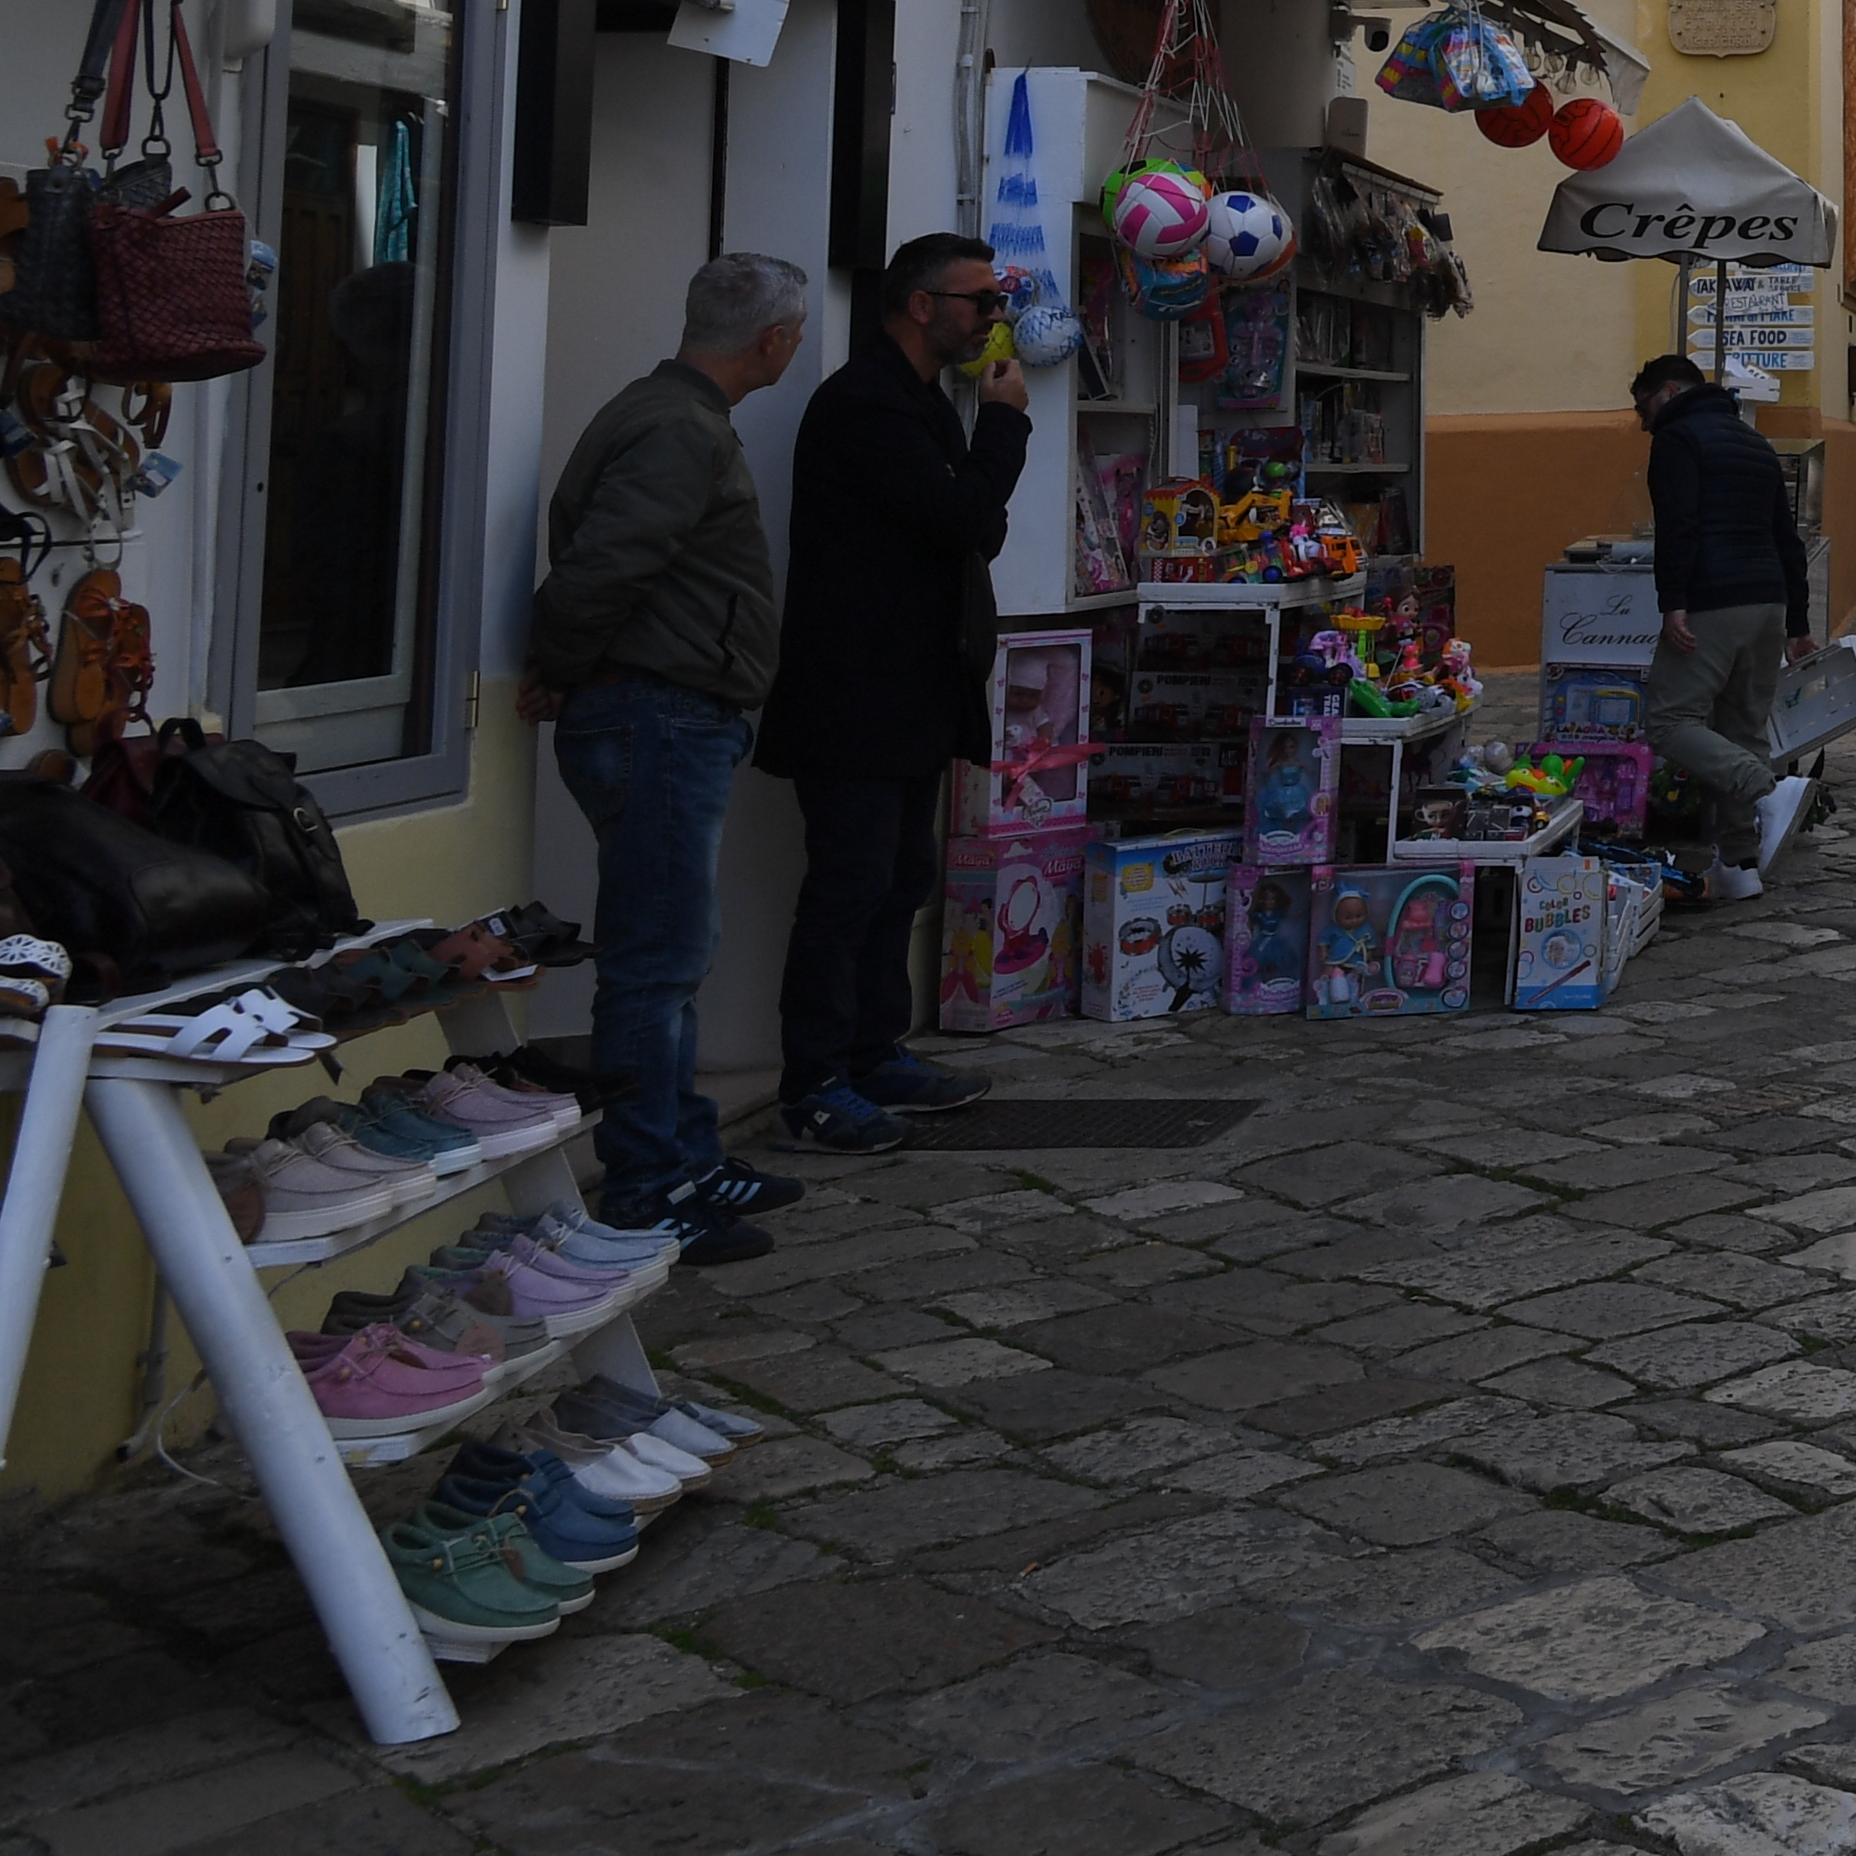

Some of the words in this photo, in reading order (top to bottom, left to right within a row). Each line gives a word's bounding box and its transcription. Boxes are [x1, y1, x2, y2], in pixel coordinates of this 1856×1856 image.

[1580, 202, 1799, 249] Crêpes
[1722, 330, 1745, 345] SEA
[1750, 330, 1788, 345] FOOD
[1109, 745, 1164, 757] POMPIERI
[954, 853, 991, 867] Maya
[1044, 856, 1083, 876] Maya
[1539, 896, 1569, 911] COLOR
[1524, 904, 1591, 933] BUBBLES
